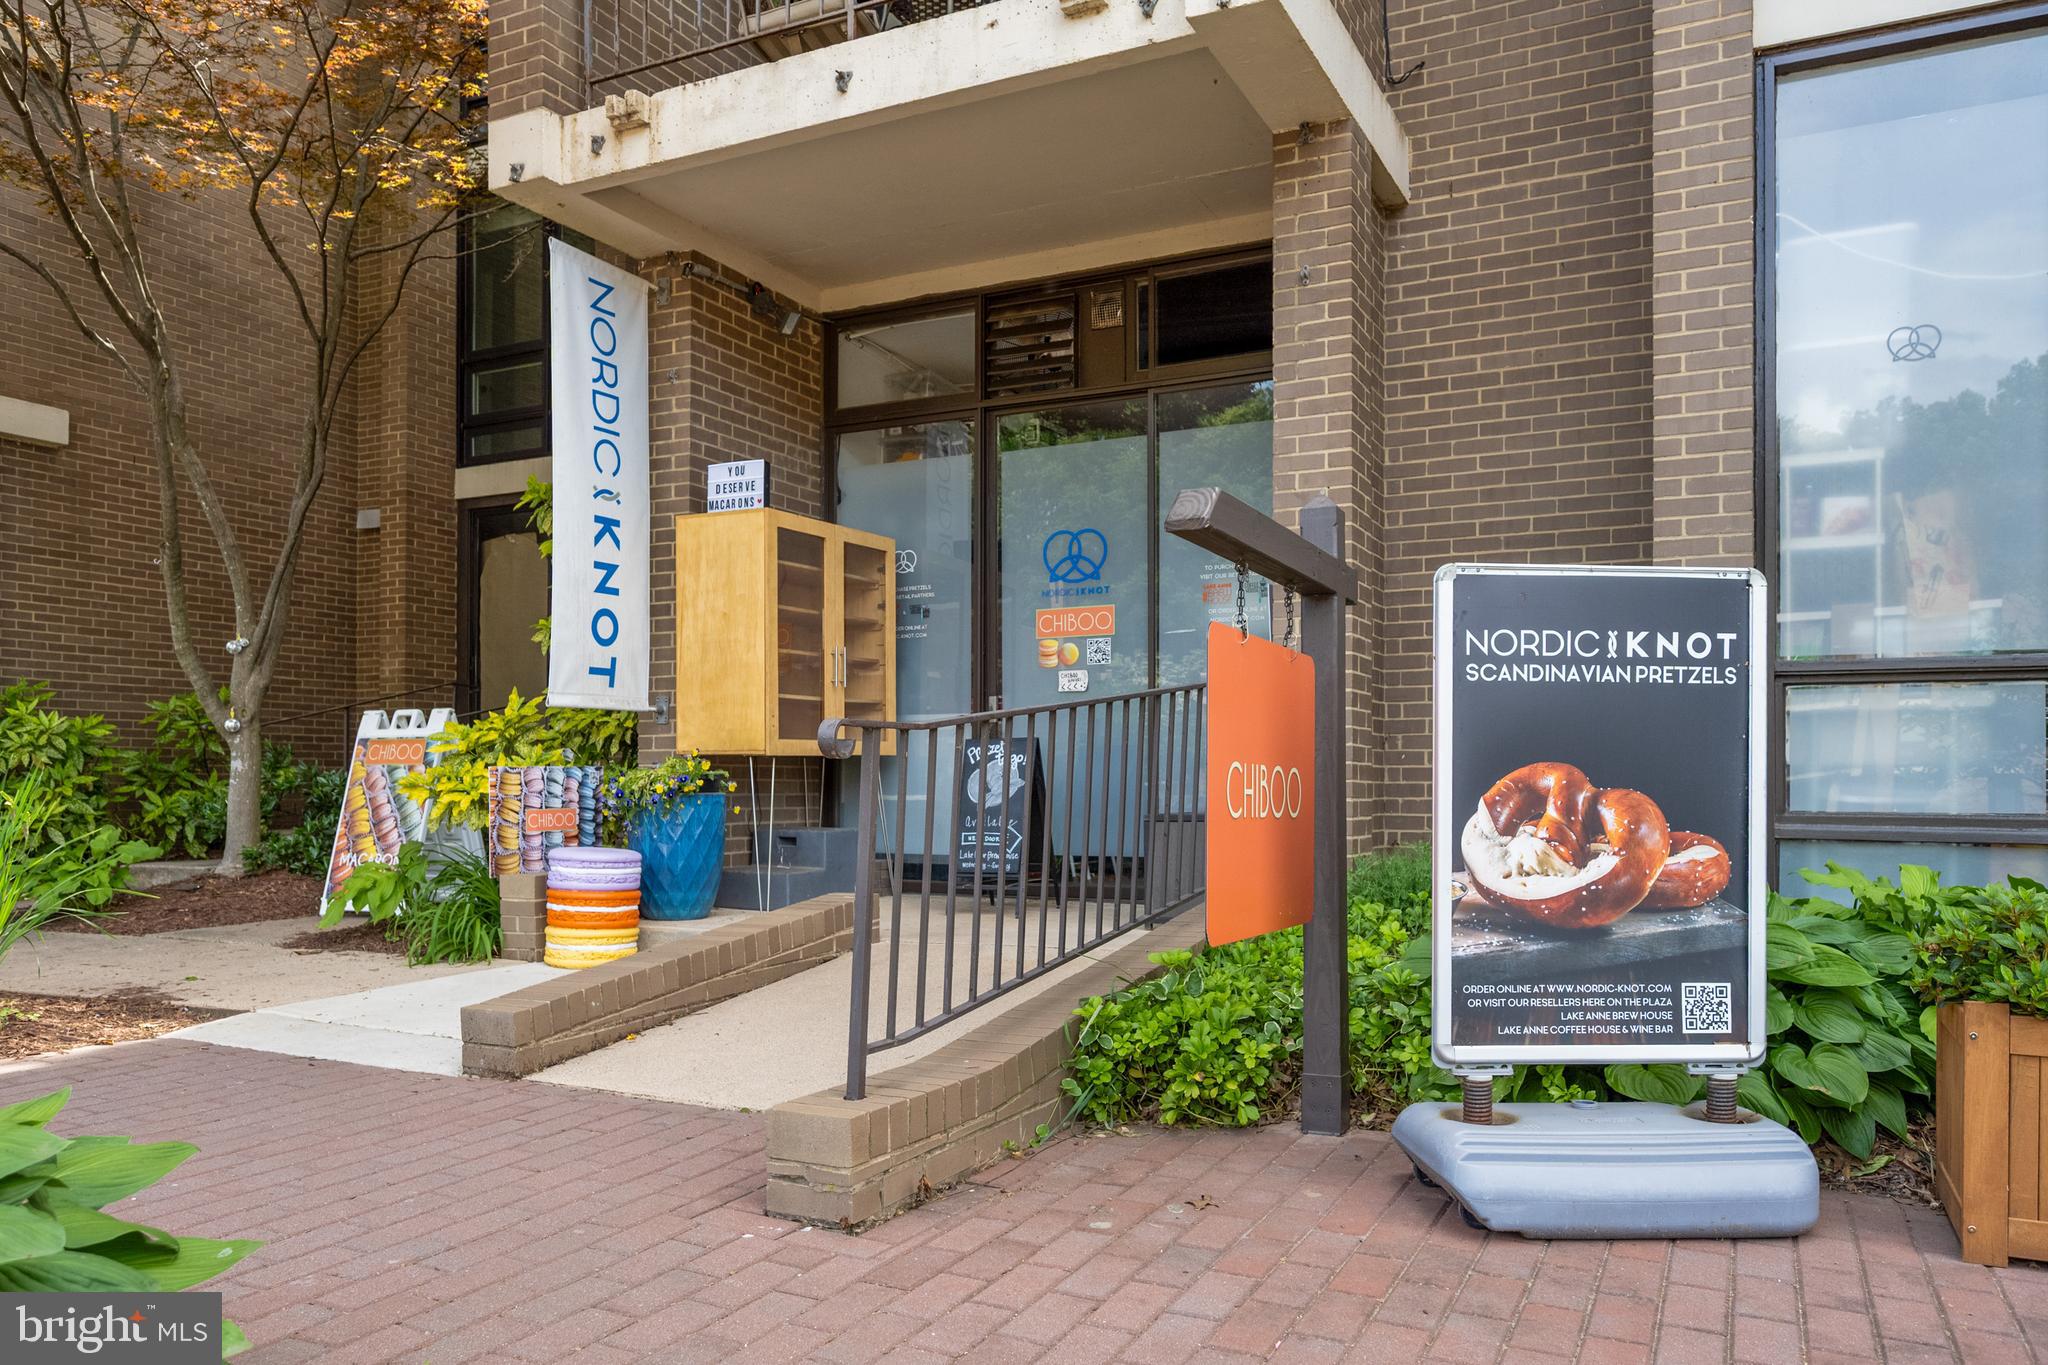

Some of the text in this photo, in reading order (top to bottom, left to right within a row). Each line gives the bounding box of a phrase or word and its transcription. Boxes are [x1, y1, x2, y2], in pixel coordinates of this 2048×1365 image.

[727, 465, 746, 477] YOU
[587, 276, 621, 689] NORDIC KNOT
[715, 480, 756, 495] DESERVE
[708, 497, 755, 511] MACARONS
[1081, 586, 1110, 595] KNOT
[1039, 611, 1112, 633] CHIBOO
[1465, 629, 1737, 660] NORDIC KNOT
[1465, 663, 1737, 685] SCANDINAVIAN PRETZELS
[368, 743, 423, 760] CHIBOO
[1226, 760, 1303, 819] CHIBOO
[527, 812, 575, 829] CHIBOO
[1462, 984, 1672, 994] ORDER ONLINE AT WWW.NORDIC-KNOT.COM
[1467, 998, 1673, 1007] OR VISIT OUR RESELLERS HERE ON THE PLAZA
[1560, 1011, 1673, 1020] LAKE ANNE BREW HOUSE
[1497, 1025, 1673, 1035] LAKE ANNE COFFEE HOUSE & WINE BAR
